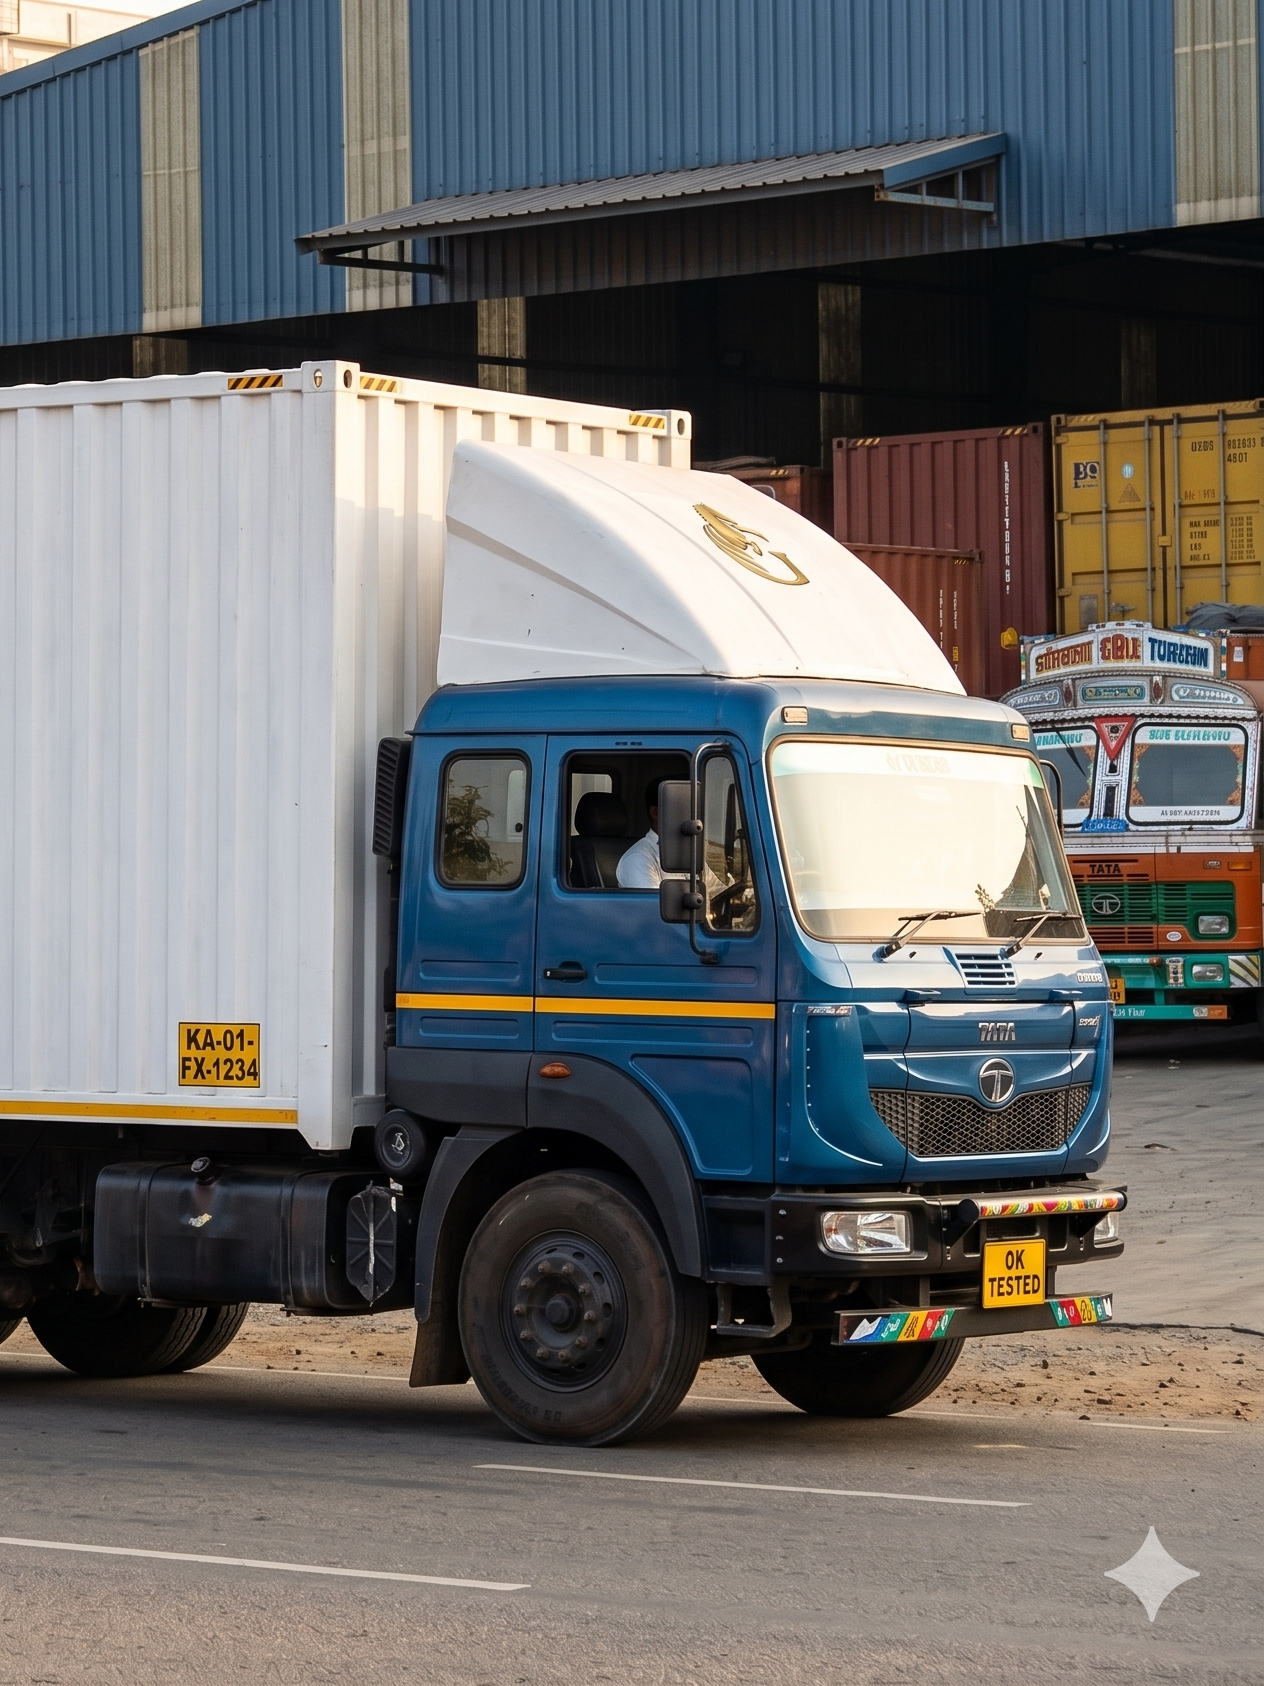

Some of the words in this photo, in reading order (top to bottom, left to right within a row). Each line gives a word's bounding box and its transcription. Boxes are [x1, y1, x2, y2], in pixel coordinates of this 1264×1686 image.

[1089, 864, 1121, 874] TATA
[186, 1028, 254, 1051] KA-01-
[979, 1022, 1016, 1041] TATA
[181, 1056, 258, 1081] FX-1234
[1005, 1248, 1025, 1271] OK
[988, 1273, 1041, 1298] TESTED
